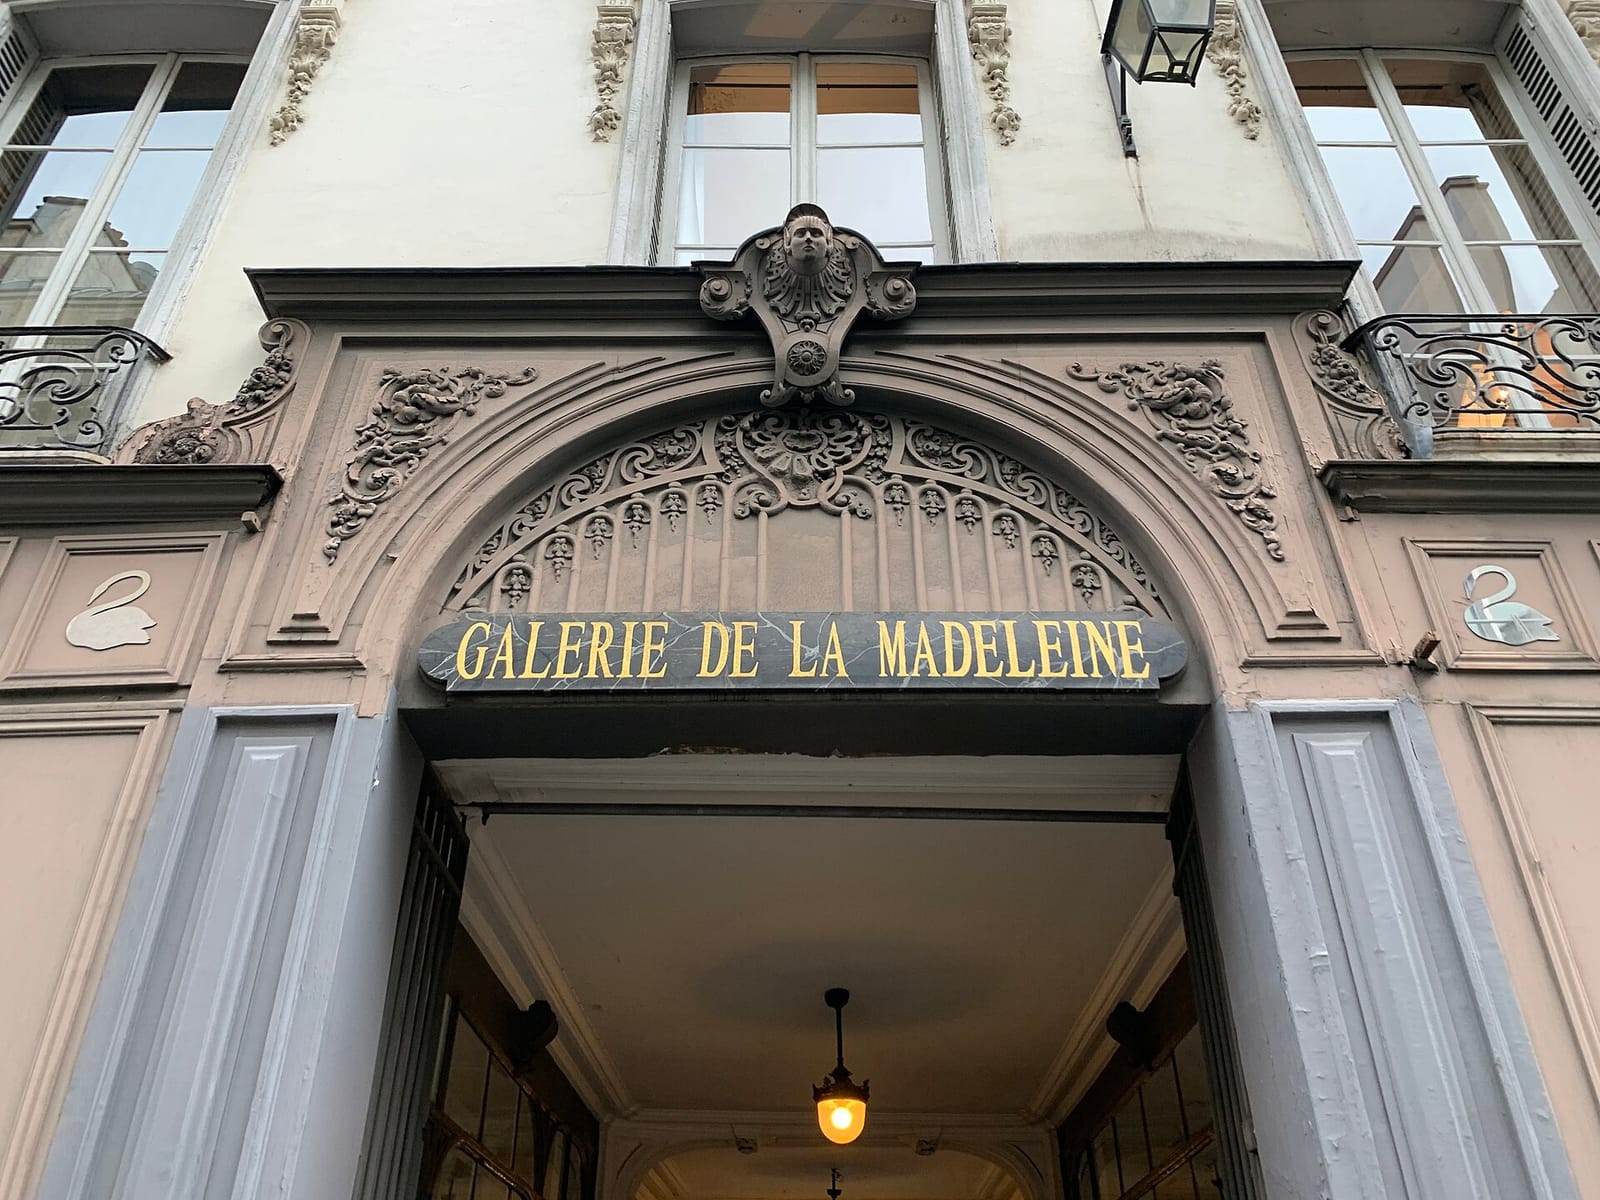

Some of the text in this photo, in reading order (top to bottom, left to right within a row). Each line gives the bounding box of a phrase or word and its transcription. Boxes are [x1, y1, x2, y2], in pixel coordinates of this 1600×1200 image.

[456, 620, 1151, 679] GALERIE DE LA MADELEINE
